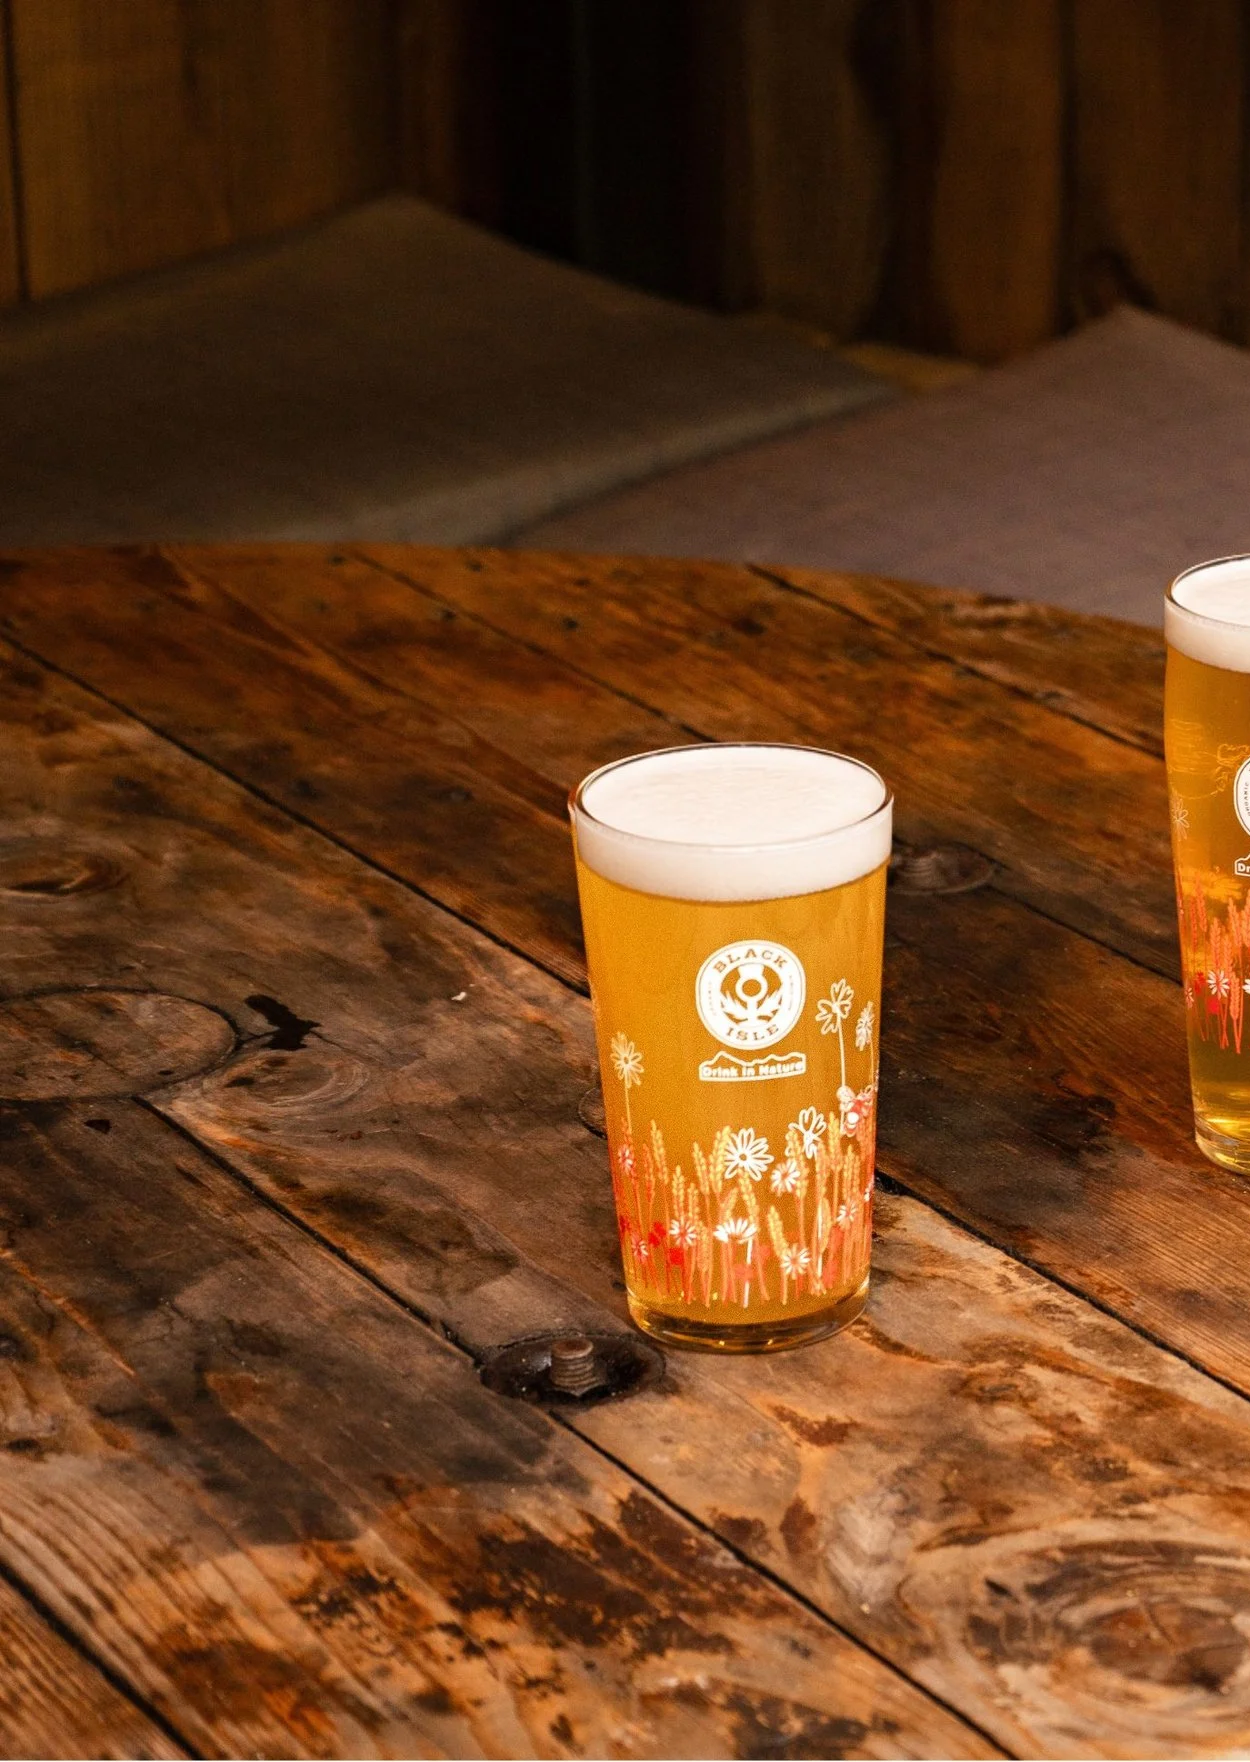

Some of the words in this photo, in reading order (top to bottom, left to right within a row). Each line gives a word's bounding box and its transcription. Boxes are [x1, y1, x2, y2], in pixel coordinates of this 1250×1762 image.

[713, 947, 788, 973] BLACK
[726, 1024, 779, 1041] ISLE
[702, 1065, 739, 1078] Drink
[758, 1060, 804, 1077] Nature
